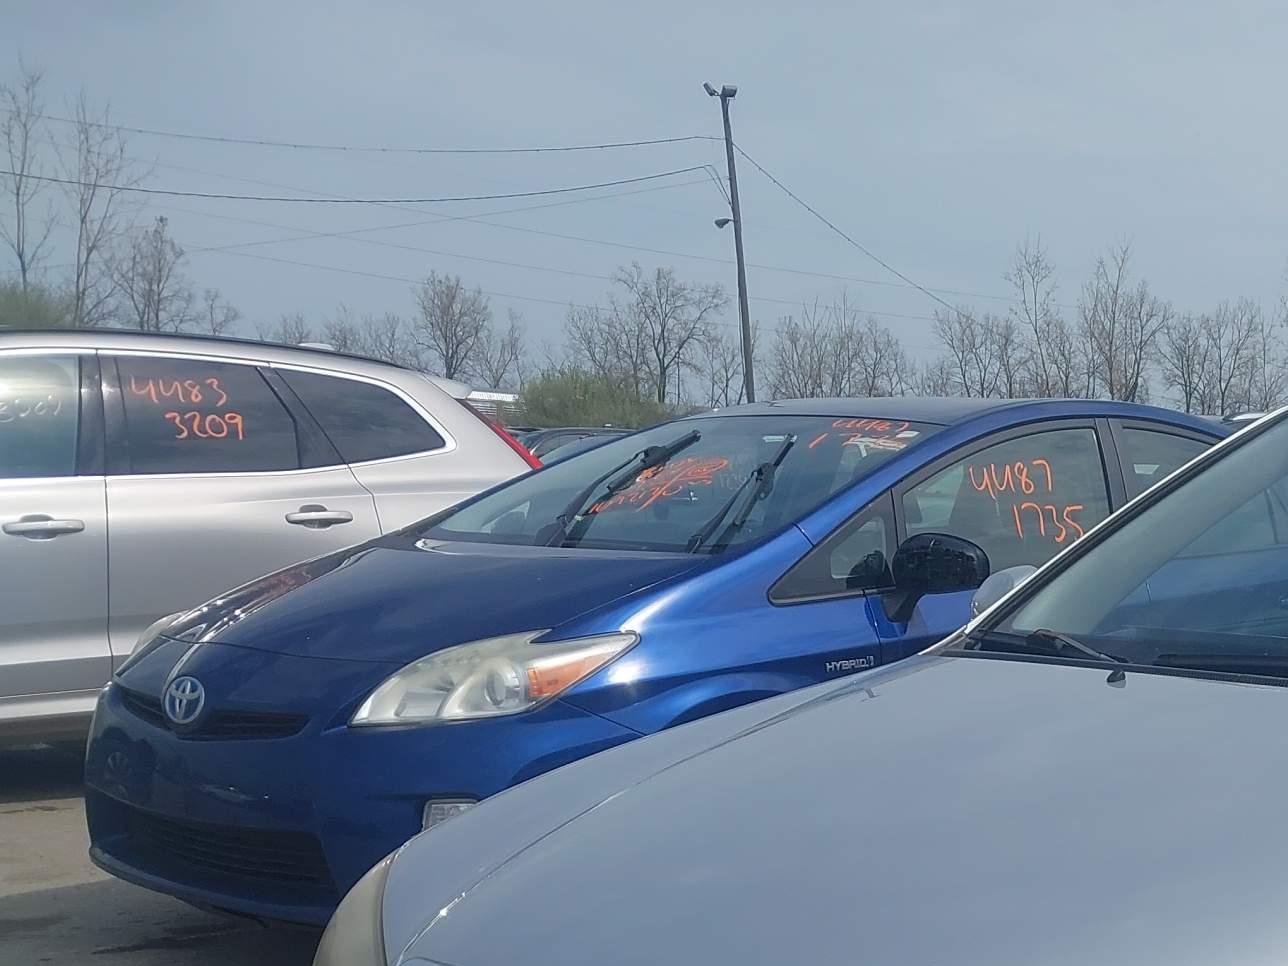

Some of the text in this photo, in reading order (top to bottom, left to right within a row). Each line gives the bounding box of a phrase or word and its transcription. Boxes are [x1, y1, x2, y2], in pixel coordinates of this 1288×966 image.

[131, 374, 227, 406] 4483
[165, 411, 243, 440] 3209
[969, 459, 1052, 500] 4487
[1013, 502, 1083, 542] 1735
[825, 658, 867, 673] HYBRID
